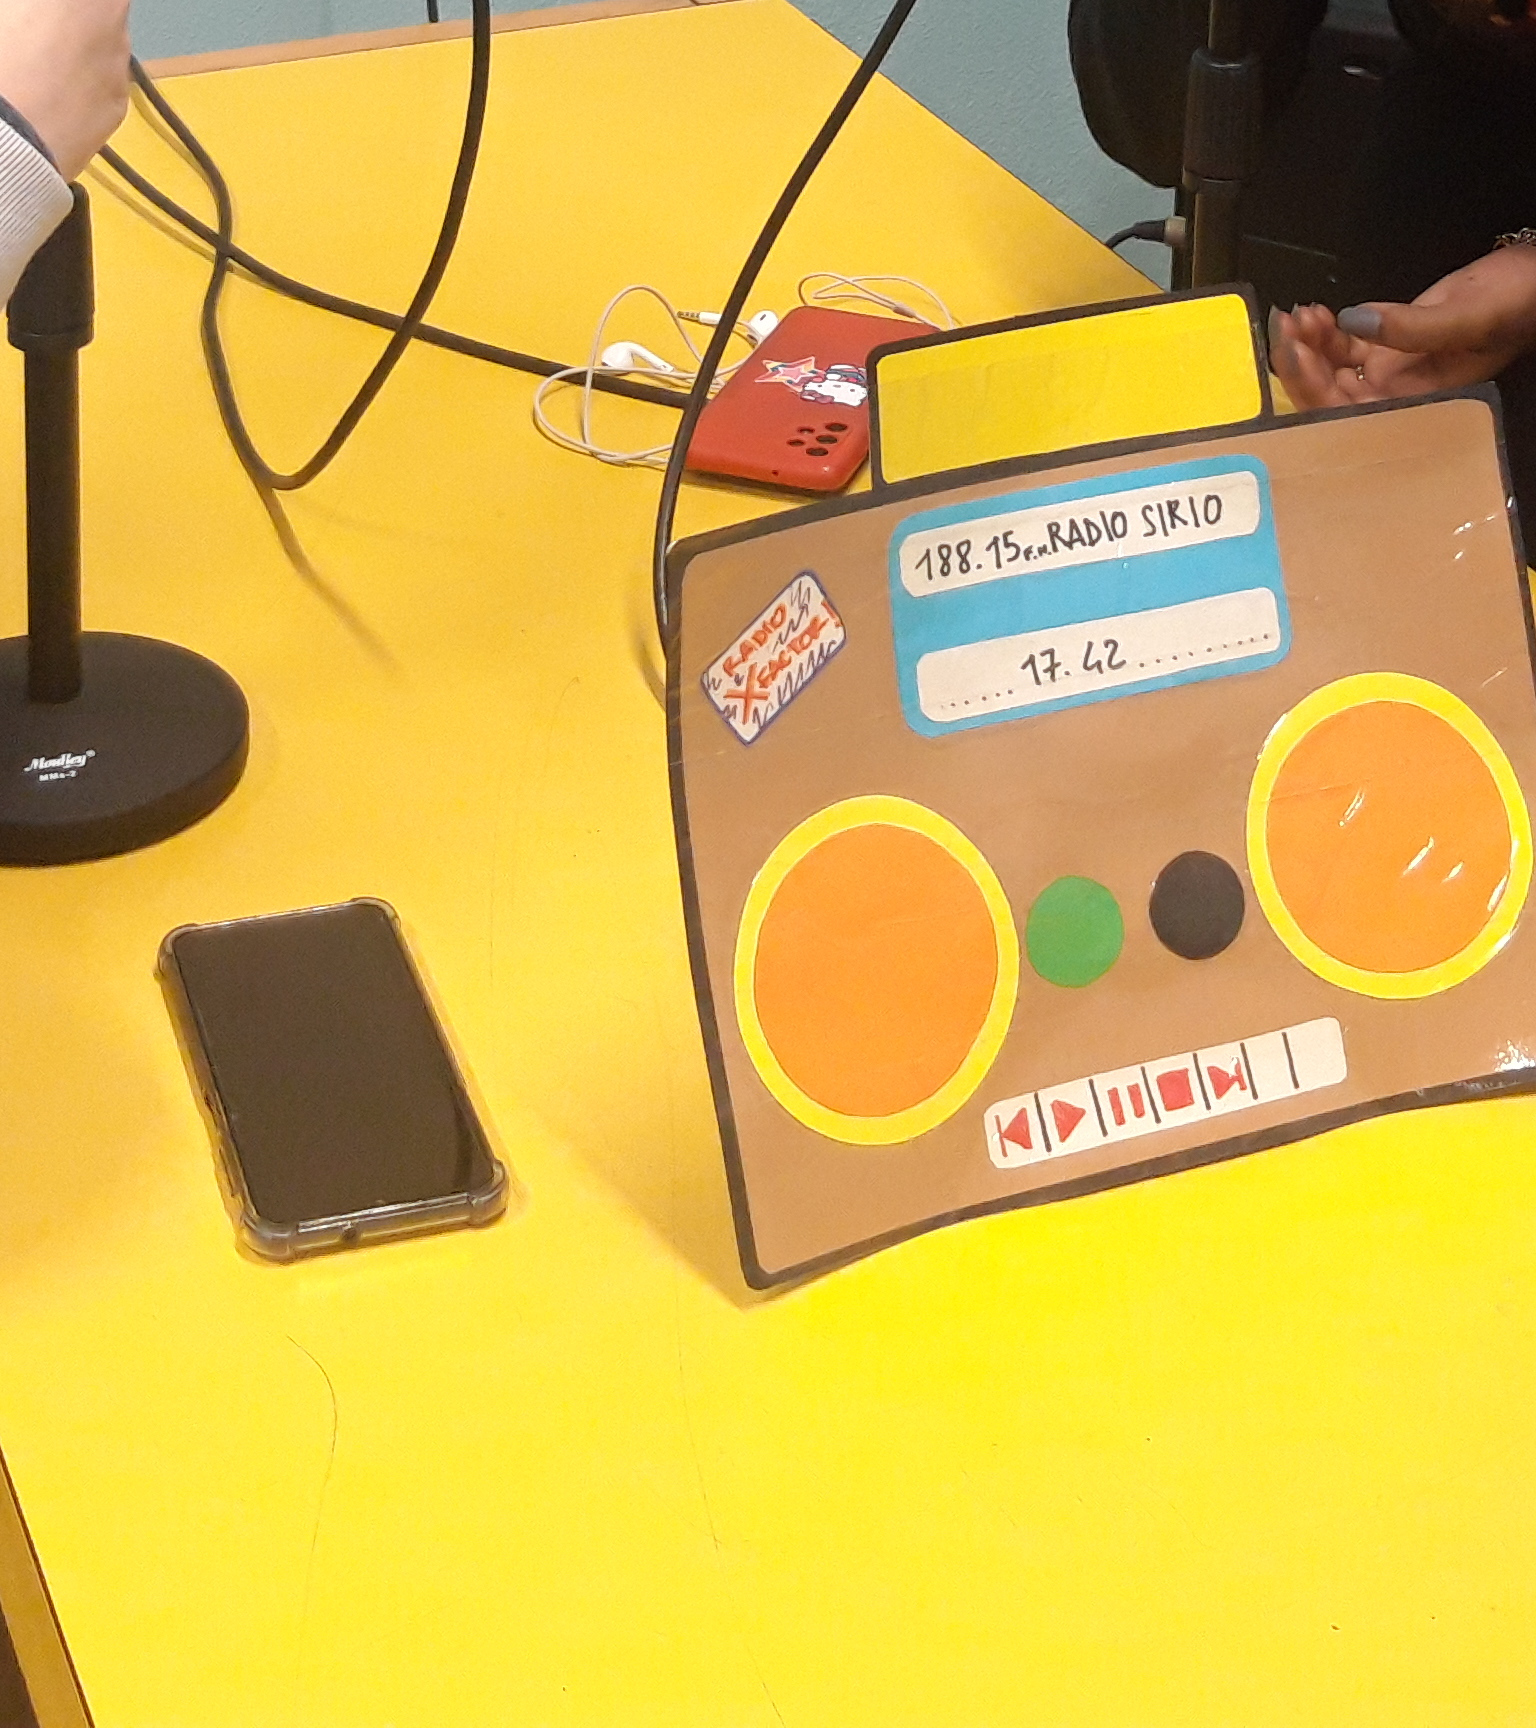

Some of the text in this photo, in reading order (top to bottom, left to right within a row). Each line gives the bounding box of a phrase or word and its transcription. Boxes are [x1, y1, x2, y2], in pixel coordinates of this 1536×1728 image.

[1047, 510, 1128, 553] RADIO
[1141, 493, 1223, 539] SIRIO
[722, 604, 787, 678] RADIO
